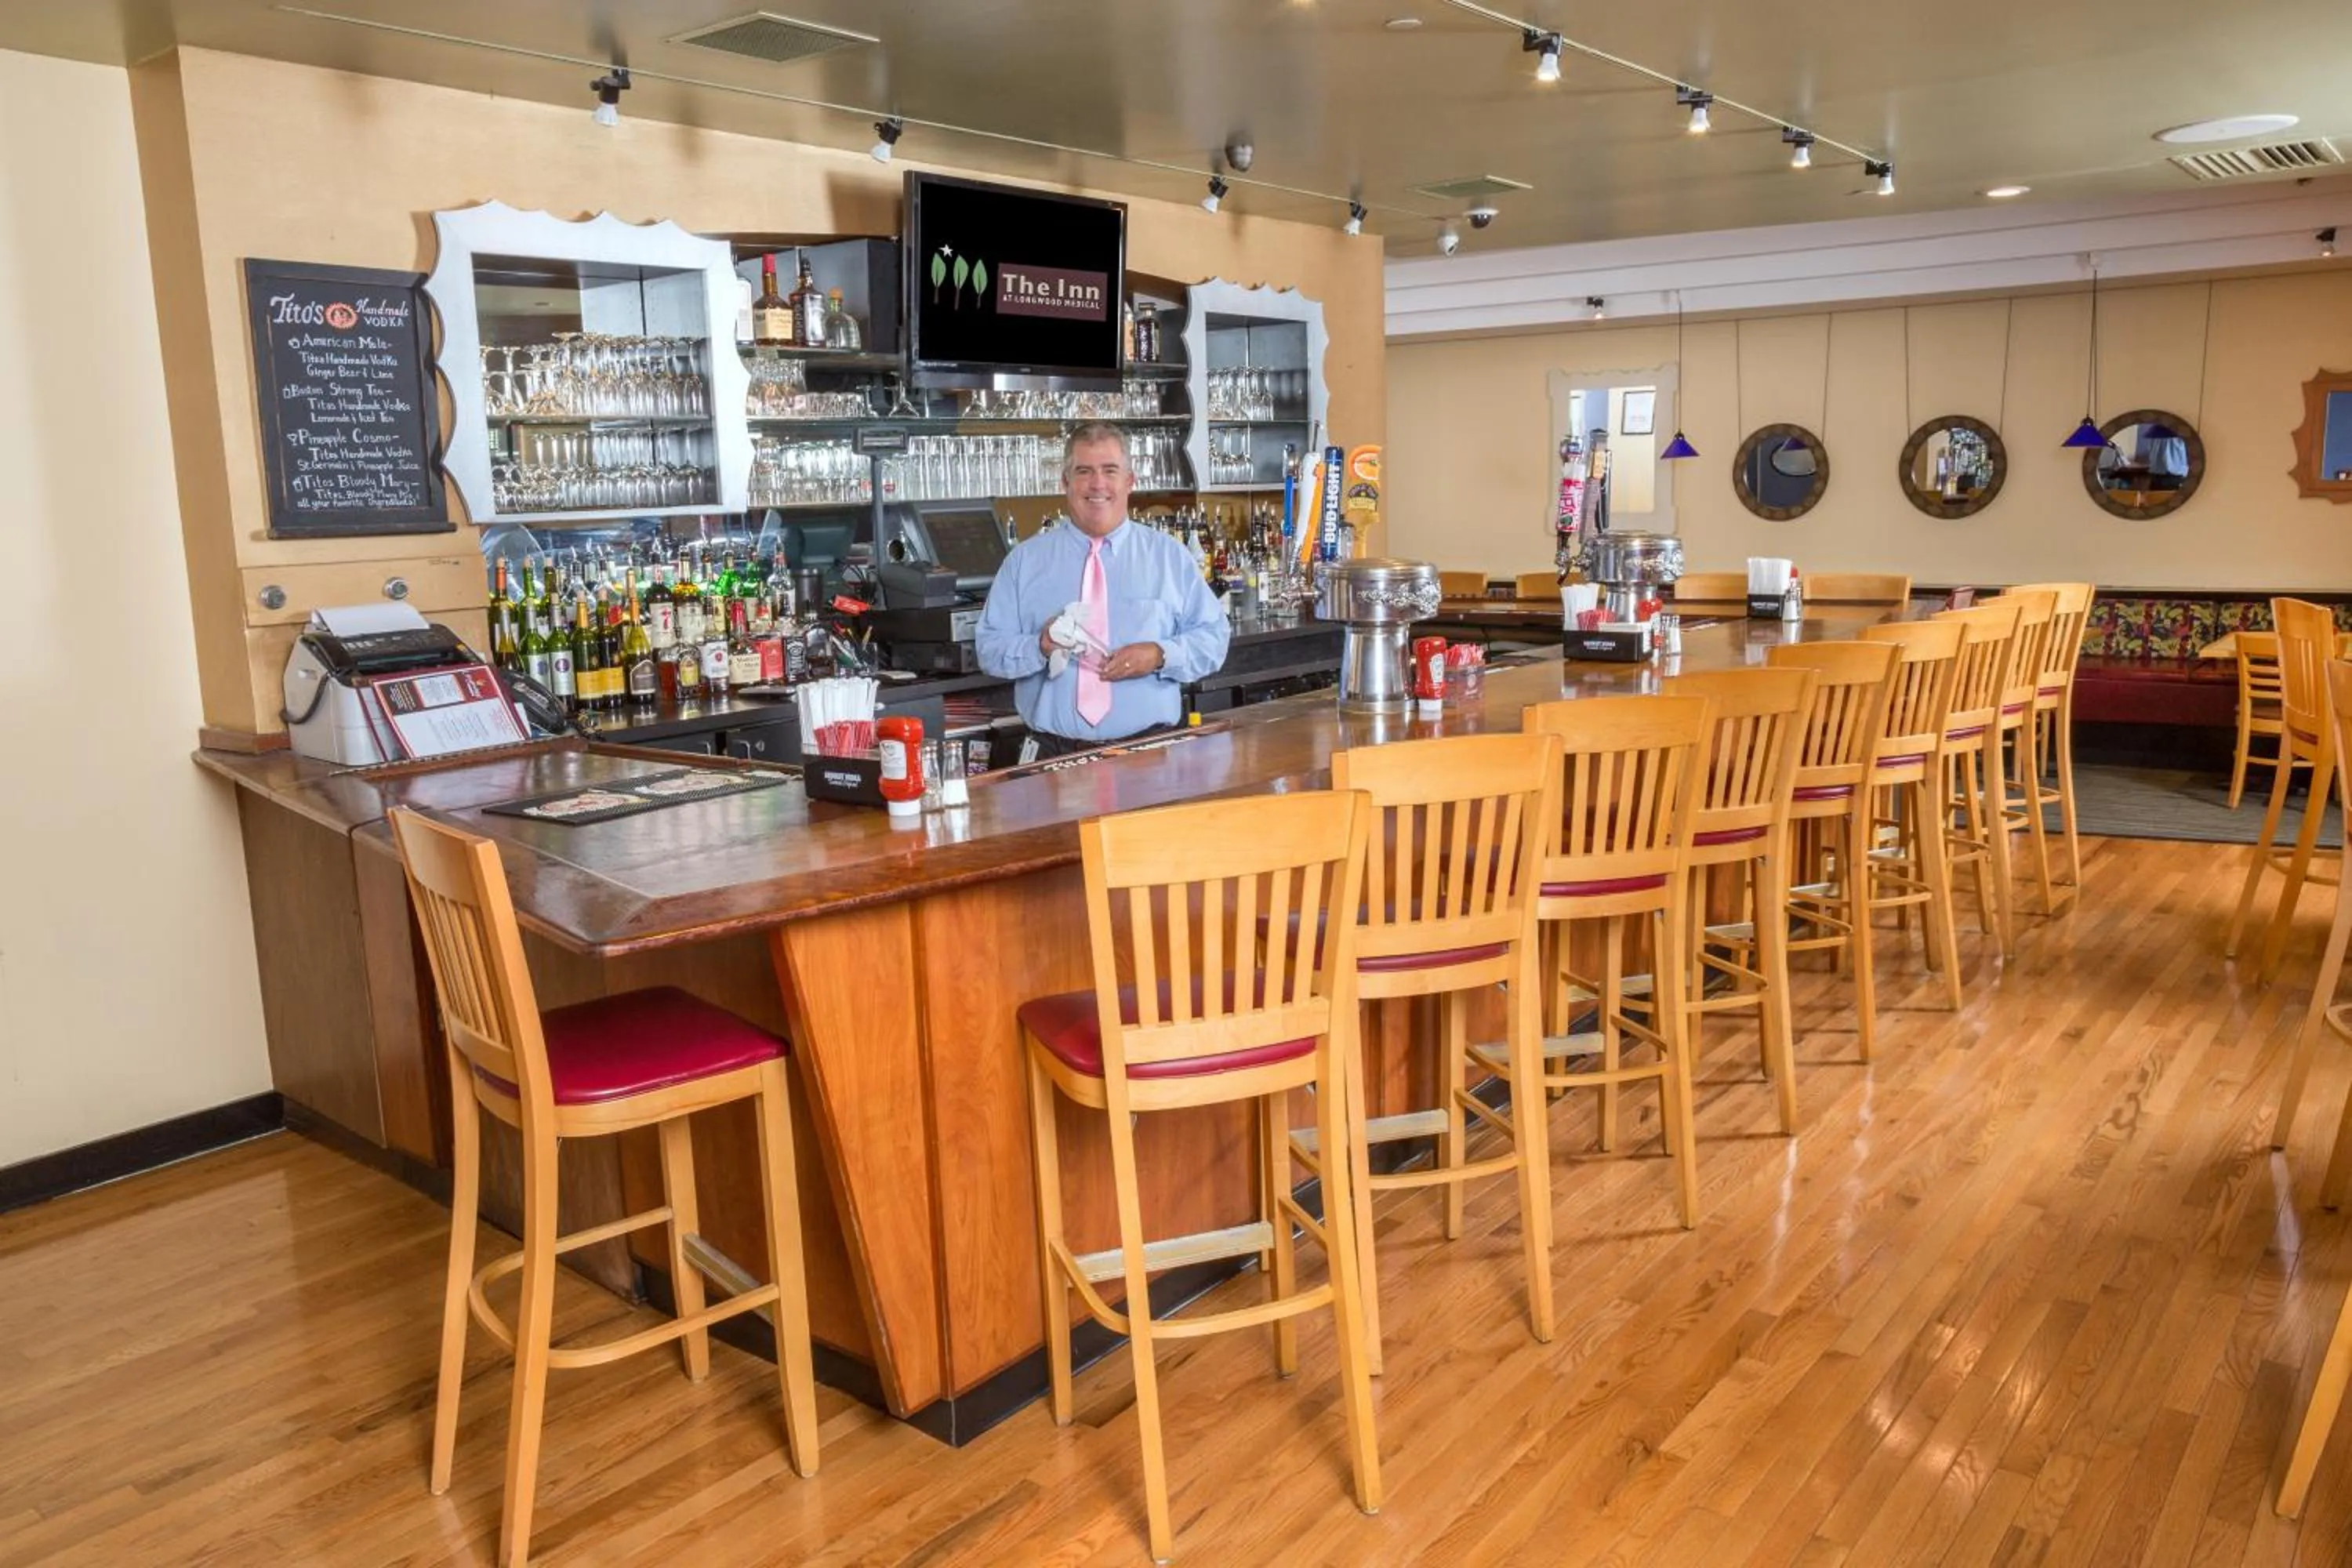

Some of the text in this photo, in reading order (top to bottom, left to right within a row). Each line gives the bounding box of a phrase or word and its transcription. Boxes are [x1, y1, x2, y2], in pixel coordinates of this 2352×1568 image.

[1002, 274, 1100, 299] The Inn
[270, 292, 325, 325] Tito's
[356, 297, 408, 317] Handmade
[1014, 295, 1062, 307] LONGWOOD
[1064, 299, 1100, 310] MEDICAL
[364, 316, 405, 327] VODKA
[302, 332, 355, 348] American
[298, 428, 347, 448] Pineapple
[337, 473, 376, 490] Bloody
[1324, 463, 1340, 543] BUD LIGHT
